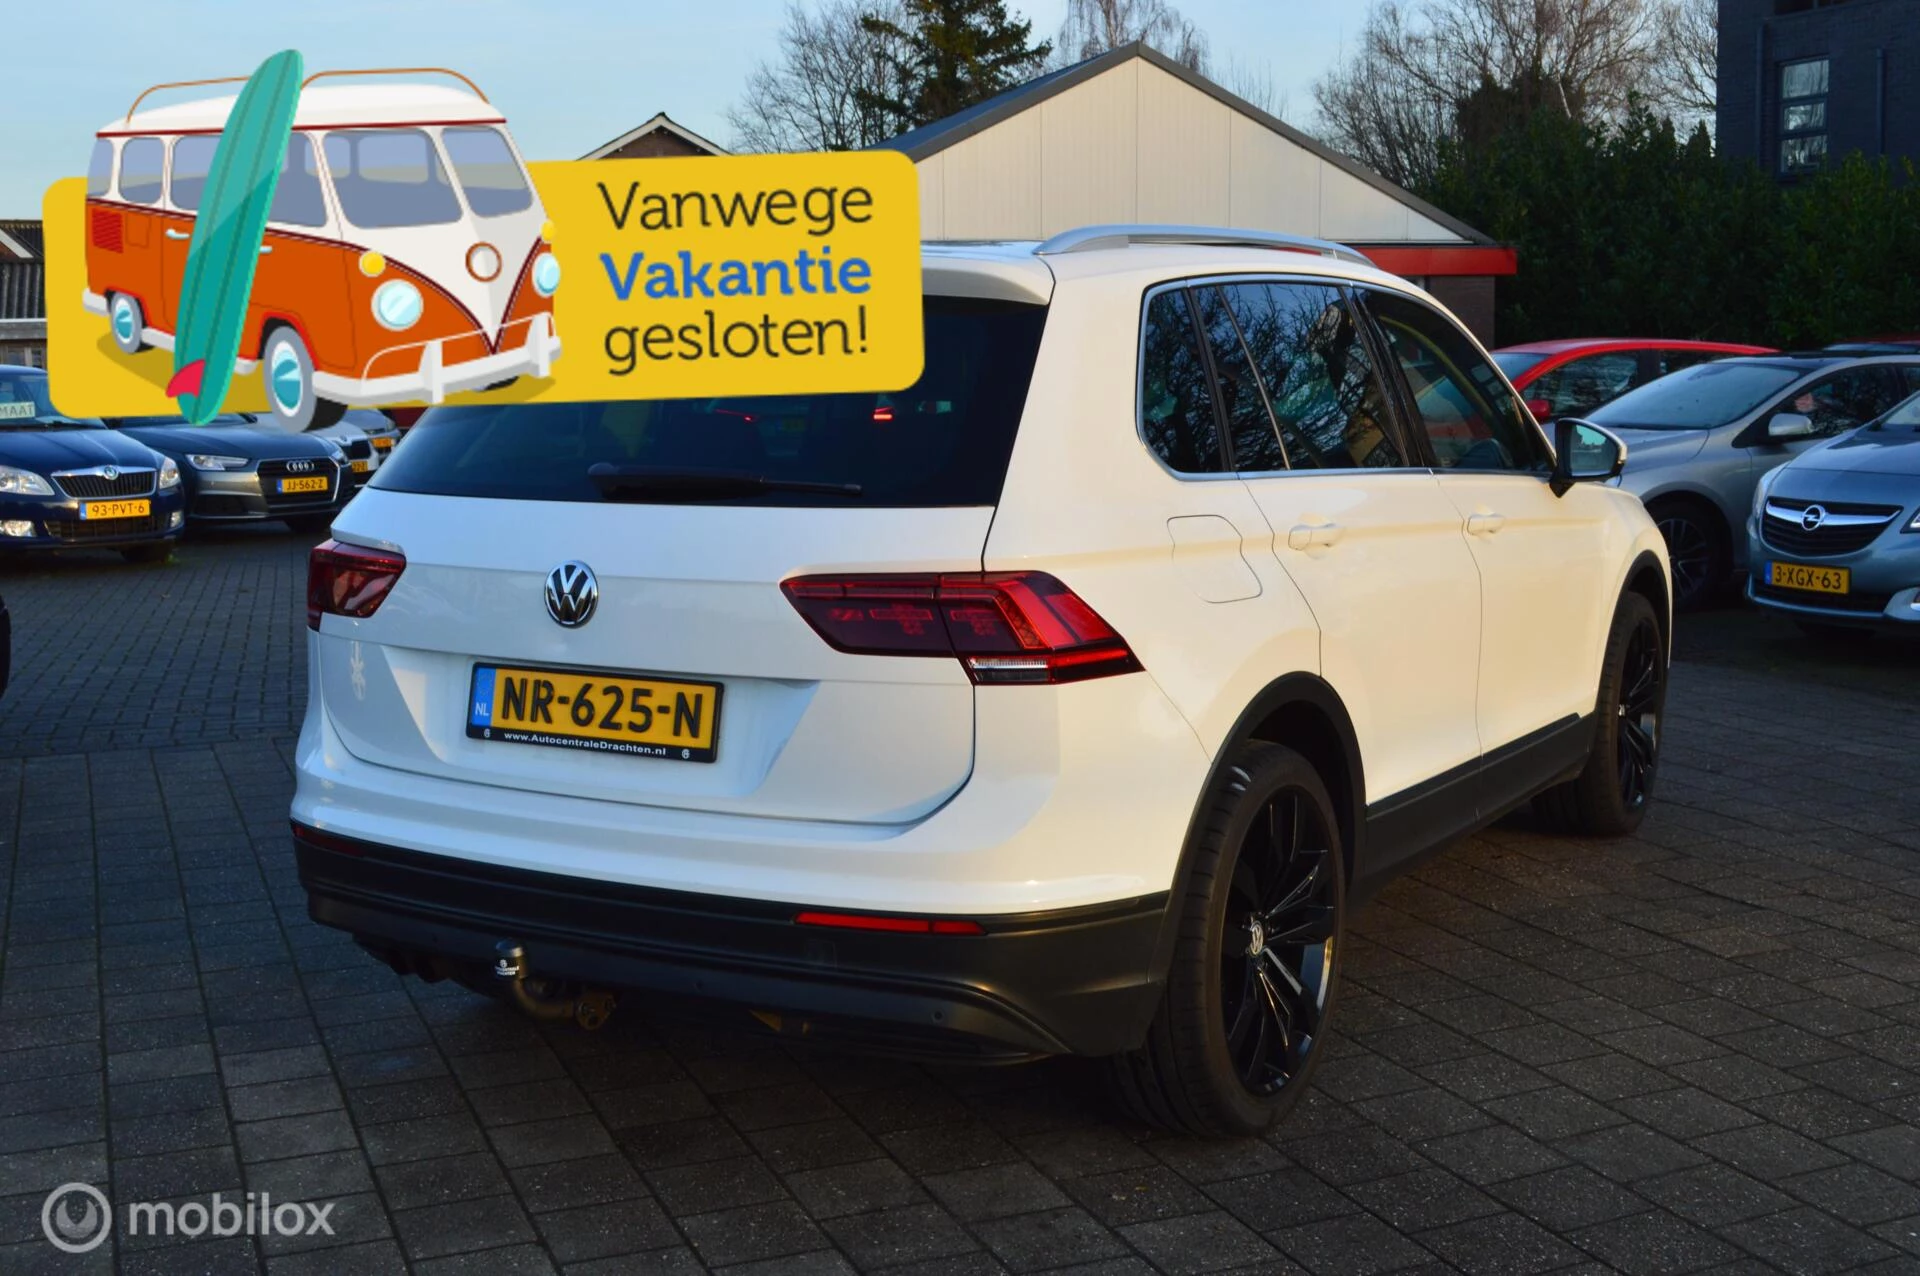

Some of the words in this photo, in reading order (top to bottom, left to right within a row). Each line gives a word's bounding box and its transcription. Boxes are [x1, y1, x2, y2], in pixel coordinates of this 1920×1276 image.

[286, 479, 324, 490] JJ-562-Z
[92, 503, 145, 516] 93-PVT-6
[1775, 566, 1842, 590] 3-XGX-63
[475, 702, 490, 716] NL
[502, 677, 703, 738] NR-625-N
[504, 733, 667, 755] www.AutocentraleDrachten.nl
